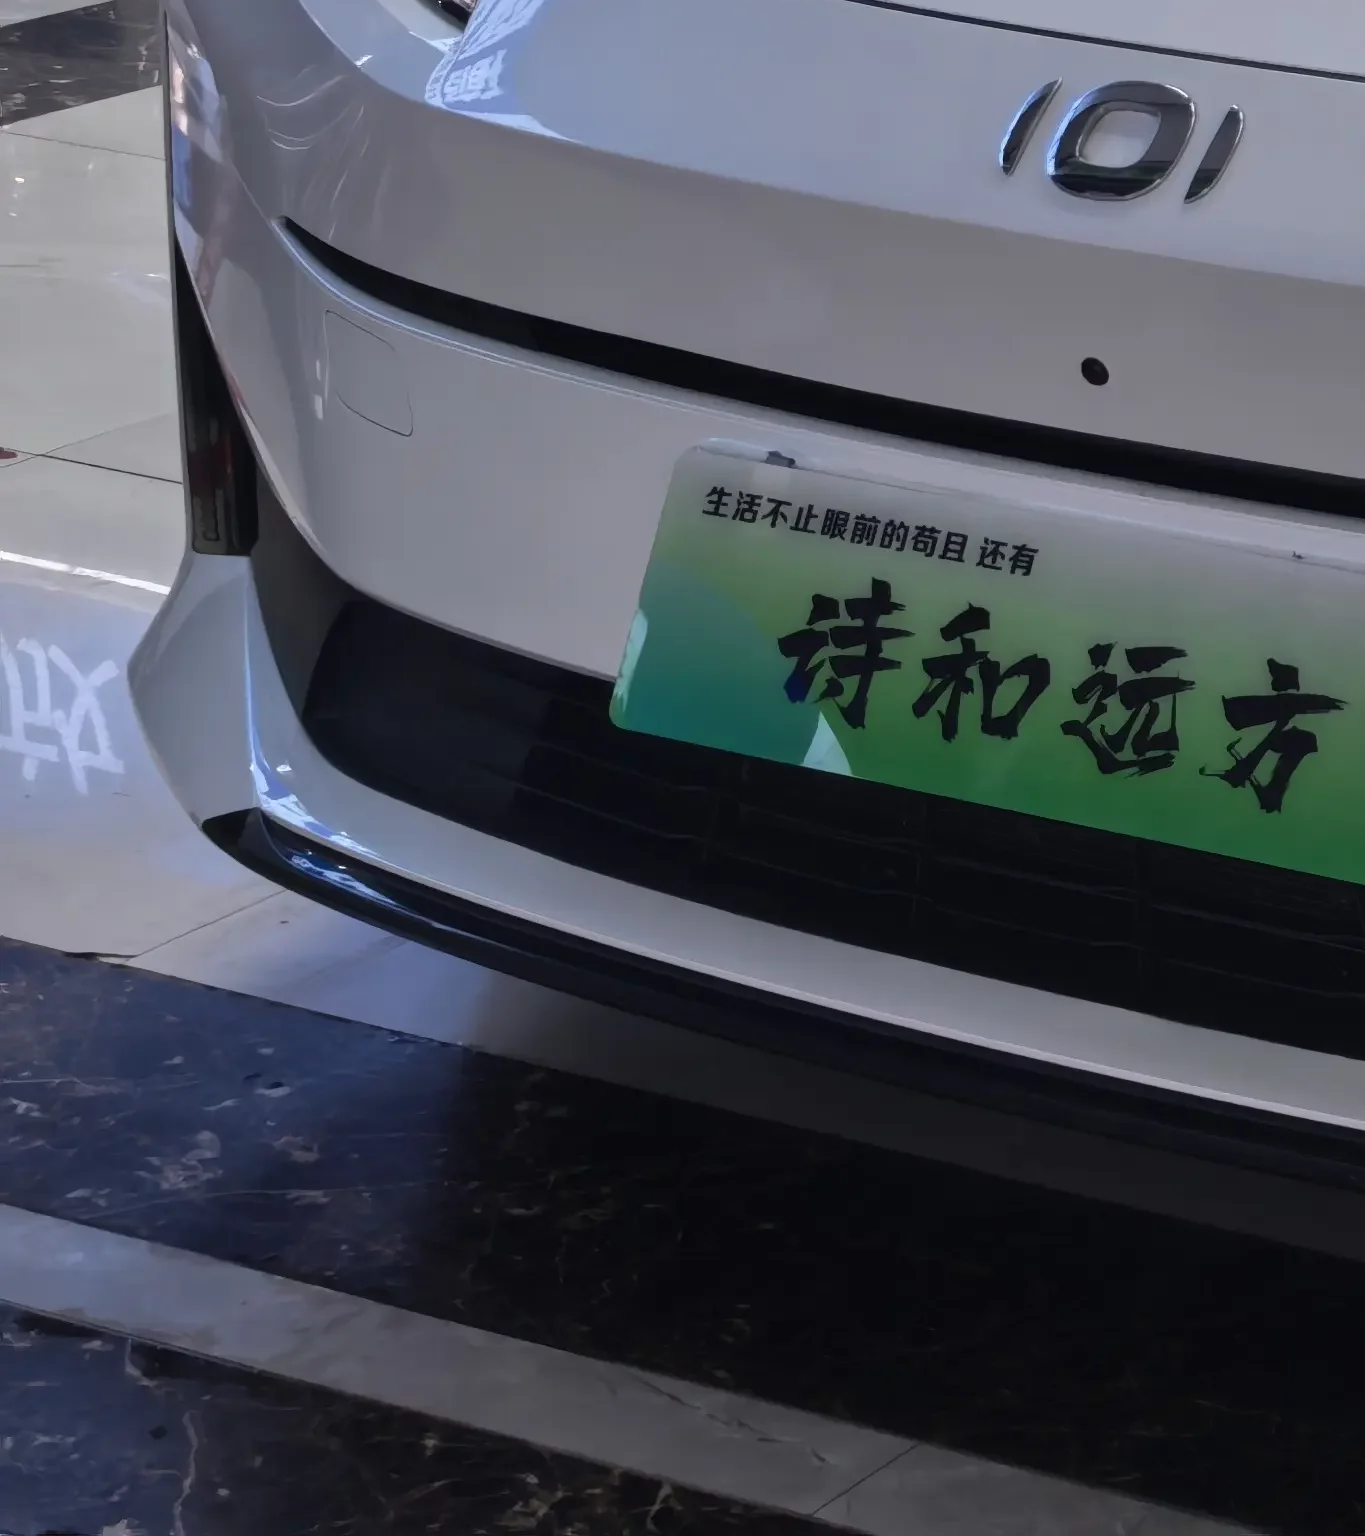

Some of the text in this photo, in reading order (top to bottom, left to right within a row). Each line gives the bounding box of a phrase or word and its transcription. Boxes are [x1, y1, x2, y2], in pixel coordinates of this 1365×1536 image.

[702, 485, 1040, 577] 生活不止眼前的苟且 还有
[777, 577, 1348, 814] 诗和远方
